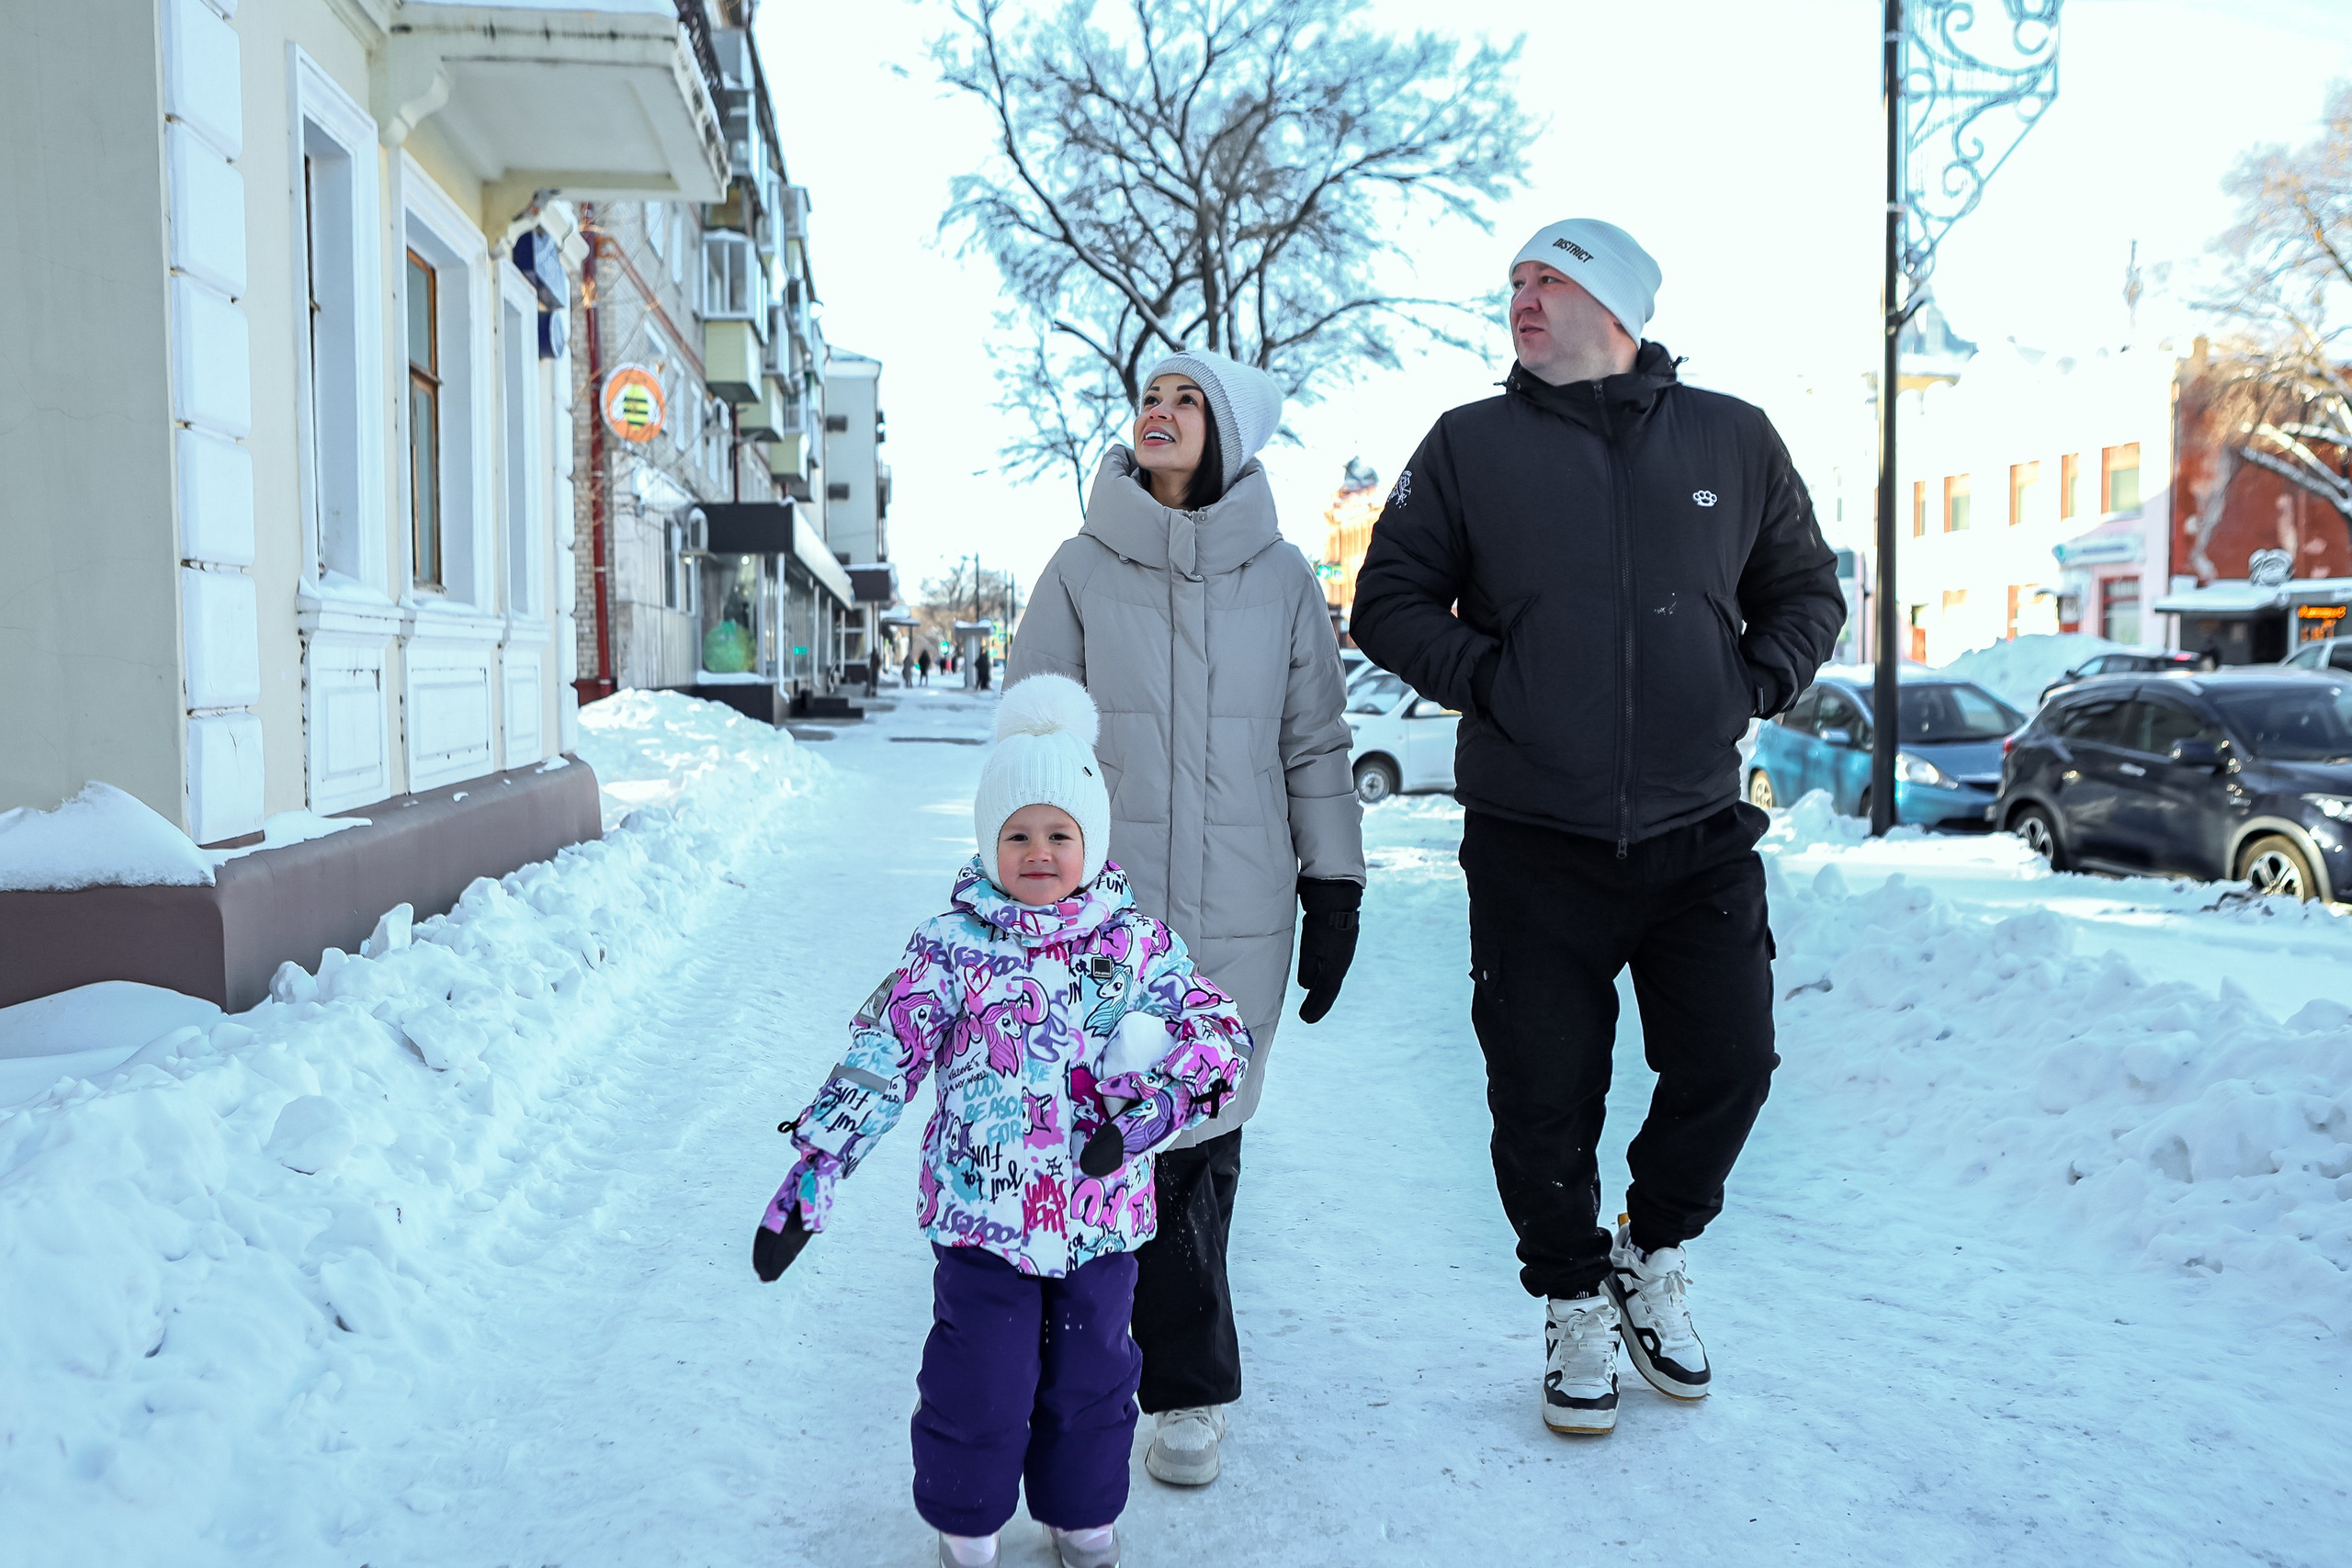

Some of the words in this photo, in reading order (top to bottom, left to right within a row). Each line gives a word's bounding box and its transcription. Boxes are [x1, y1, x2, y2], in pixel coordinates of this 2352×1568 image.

[1553, 237, 1594, 264] DISTRICT
[1096, 876, 1125, 896] FUN
[986, 1119, 1024, 1147] FOR
